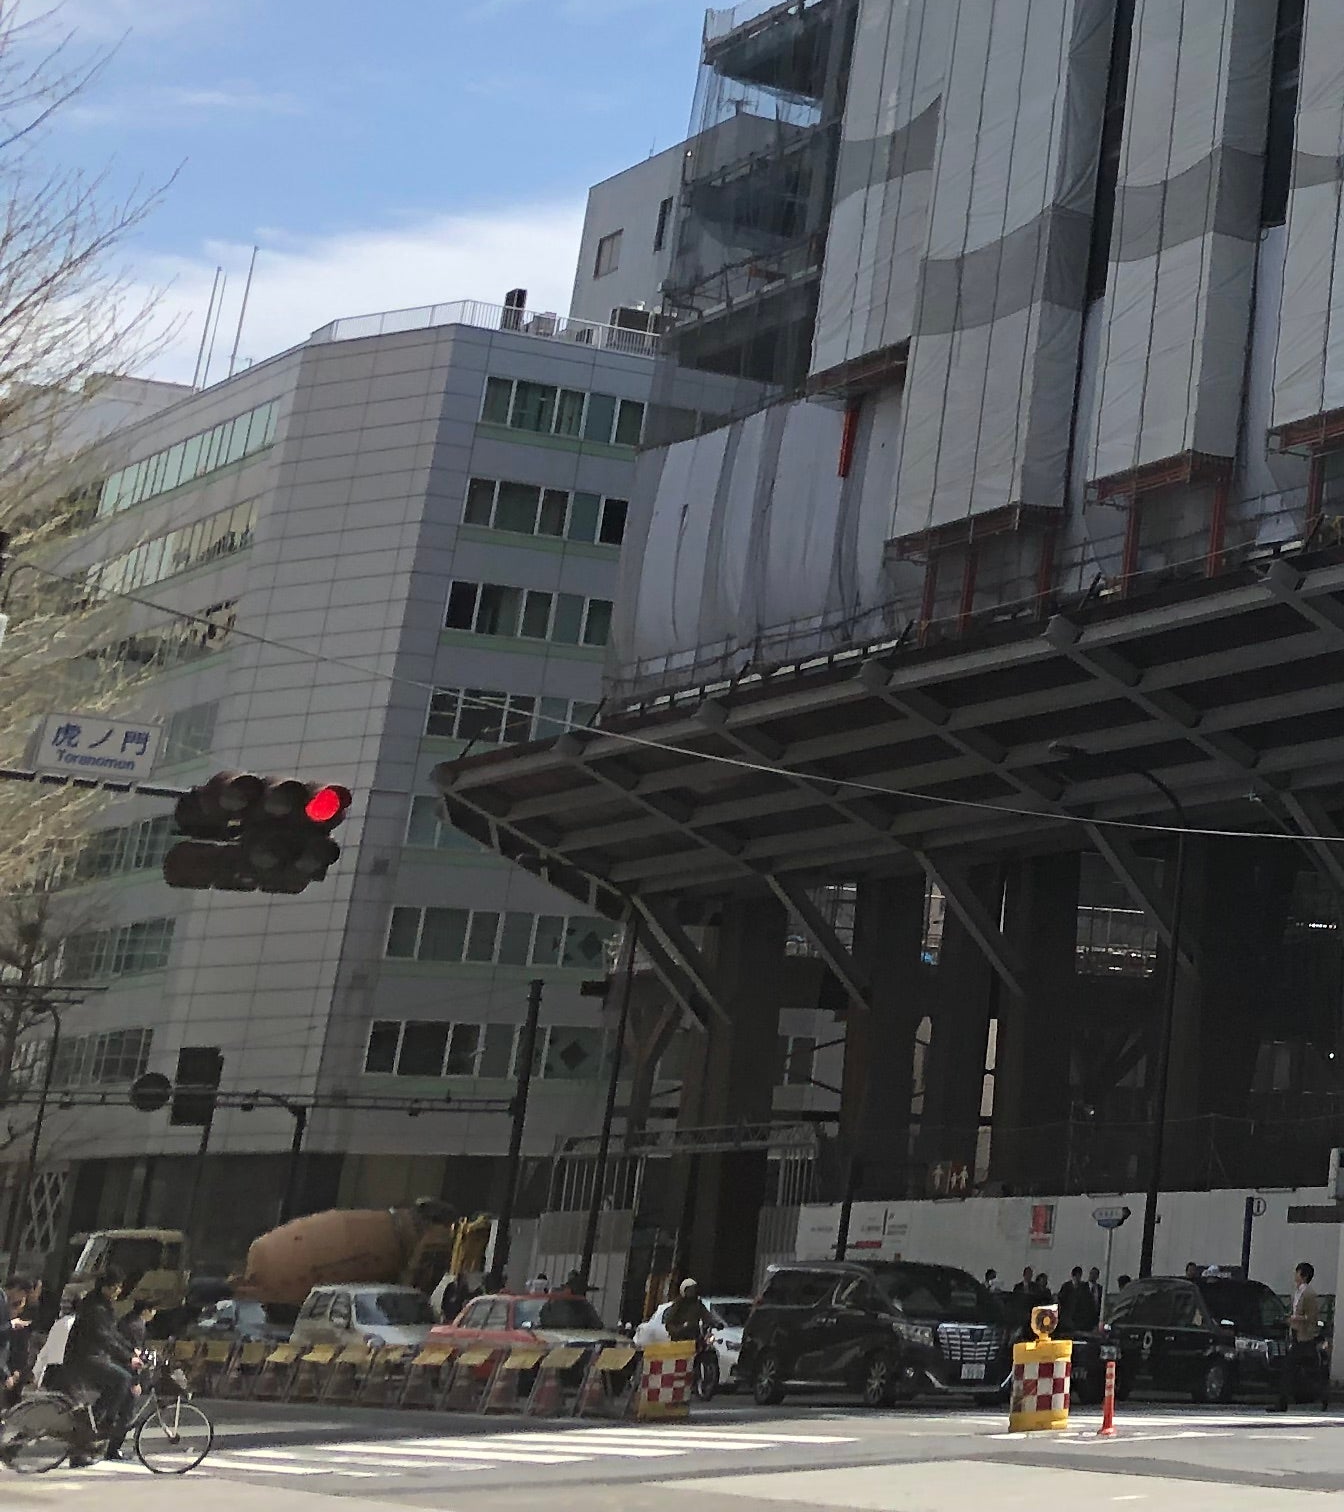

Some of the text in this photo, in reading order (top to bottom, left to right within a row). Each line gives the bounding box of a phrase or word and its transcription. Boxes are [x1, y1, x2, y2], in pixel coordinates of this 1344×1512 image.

[52, 722, 150, 756] 虎ノ門
[56, 748, 135, 771] Toranomon
